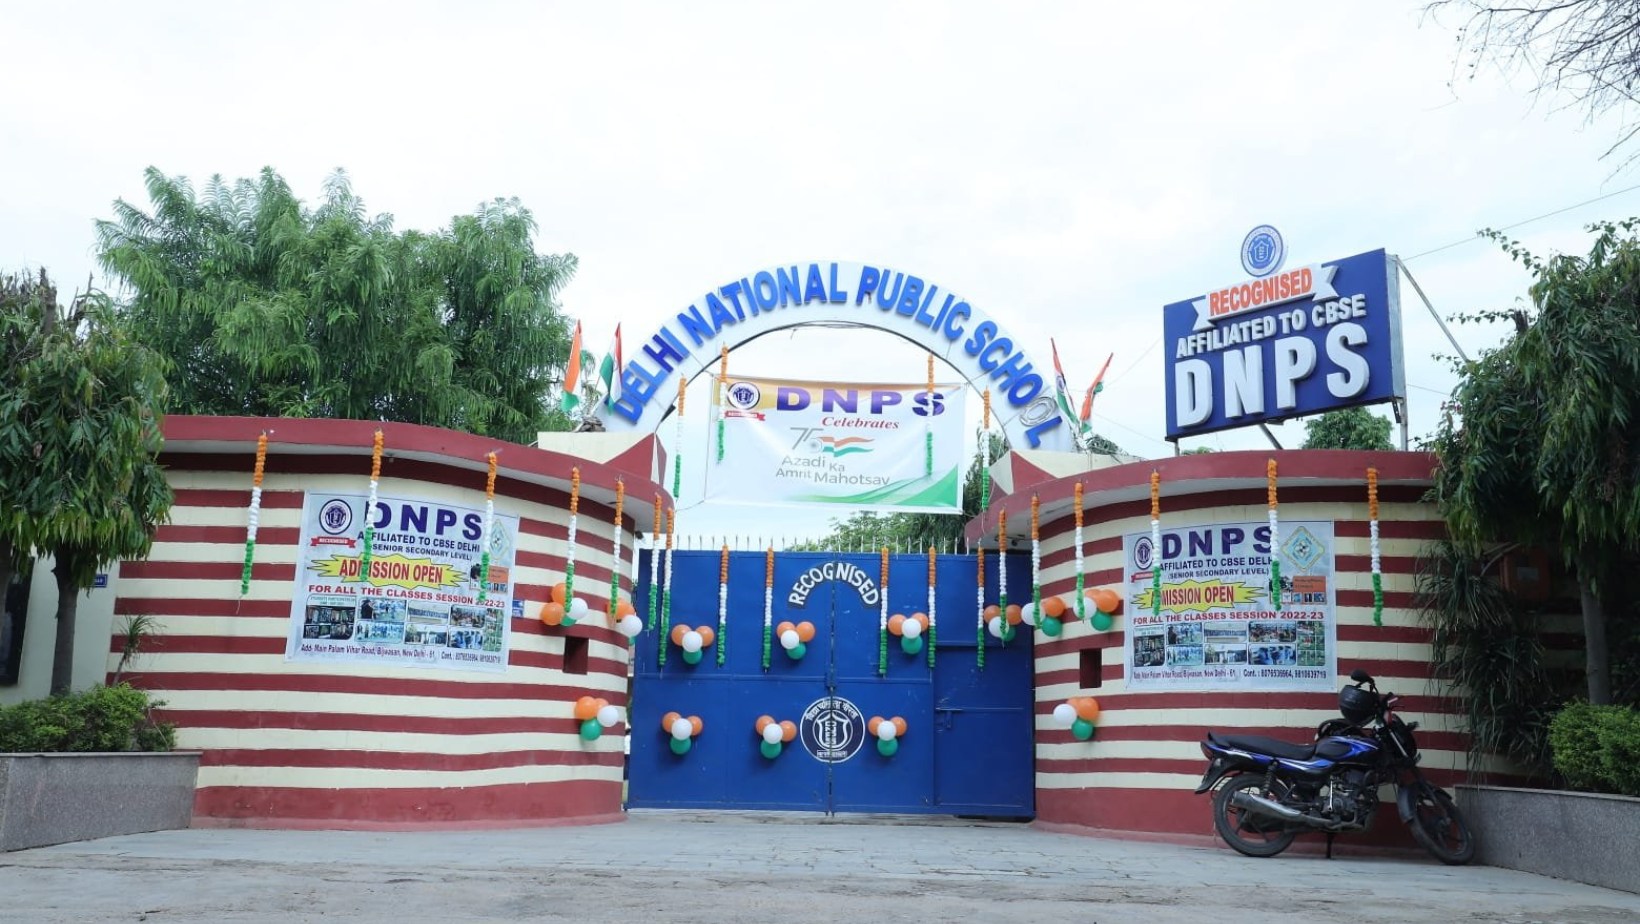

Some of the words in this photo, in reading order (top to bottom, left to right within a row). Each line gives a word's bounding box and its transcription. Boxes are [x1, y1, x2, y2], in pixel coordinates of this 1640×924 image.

[1210, 267, 1313, 317] RECOGNISED
[1176, 315, 1277, 358] AFFILIATED
[1279, 309, 1307, 334] TO
[1311, 293, 1367, 328] CBSE
[604, 326, 690, 426] DELHI
[677, 262, 848, 347] NATIONAL
[855, 265, 972, 343] PUBLIC
[1174, 322, 1371, 428] DNPS
[776, 386, 945, 416] DNPS
[822, 416, 899, 430] Celebrates
[781, 455, 826, 468] Azadi
[828, 462, 845, 472] Ka
[775, 467, 813, 479] Amrit
[813, 472, 890, 486] Mahotsav
[364, 500, 482, 541] DNPS
[357, 531, 415, 545] AFILIATED
[418, 537, 430, 547] TO
[432, 538, 455, 550] CBSE
[457, 541, 480, 553] DELHI
[1162, 526, 1272, 560] DNPS
[405, 546, 448, 559] SECONDARY
[450, 550, 472, 561] LEVEL)
[1159, 559, 1204, 571] AFFILIATED
[1206, 558, 1218, 568] TO
[1221, 557, 1245, 567] CBSE
[1248, 556, 1273, 566] DELH
[413, 565, 443, 584] OPEN
[1195, 569, 1238, 579] SECONDARY
[1241, 567, 1269, 576] LEVEL)
[788, 562, 879, 605] RECOGNISED
[308, 584, 332, 593] FOR
[334, 586, 356, 595] ALL
[362, 587, 383, 596] THE
[386, 588, 432, 600] CLASSES
[435, 592, 473, 605] SESSION
[1151, 588, 1201, 608] MISSION
[1204, 586, 1234, 603] OPEN
[1133, 616, 1148, 625] FOR
[1149, 615, 1163, 623] ALL
[1165, 614, 1182, 622] THE
[1184, 612, 1227, 621] CLASSES
[1230, 611, 1277, 620] SESSION
[1280, 611, 1324, 619] 2022-23
[346, 645, 361, 653] Vihar
[402, 649, 412, 657] New
[413, 649, 426, 657] Delhi
[1214, 669, 1226, 677] Delhi
[1243, 669, 1256, 677] Cont.
